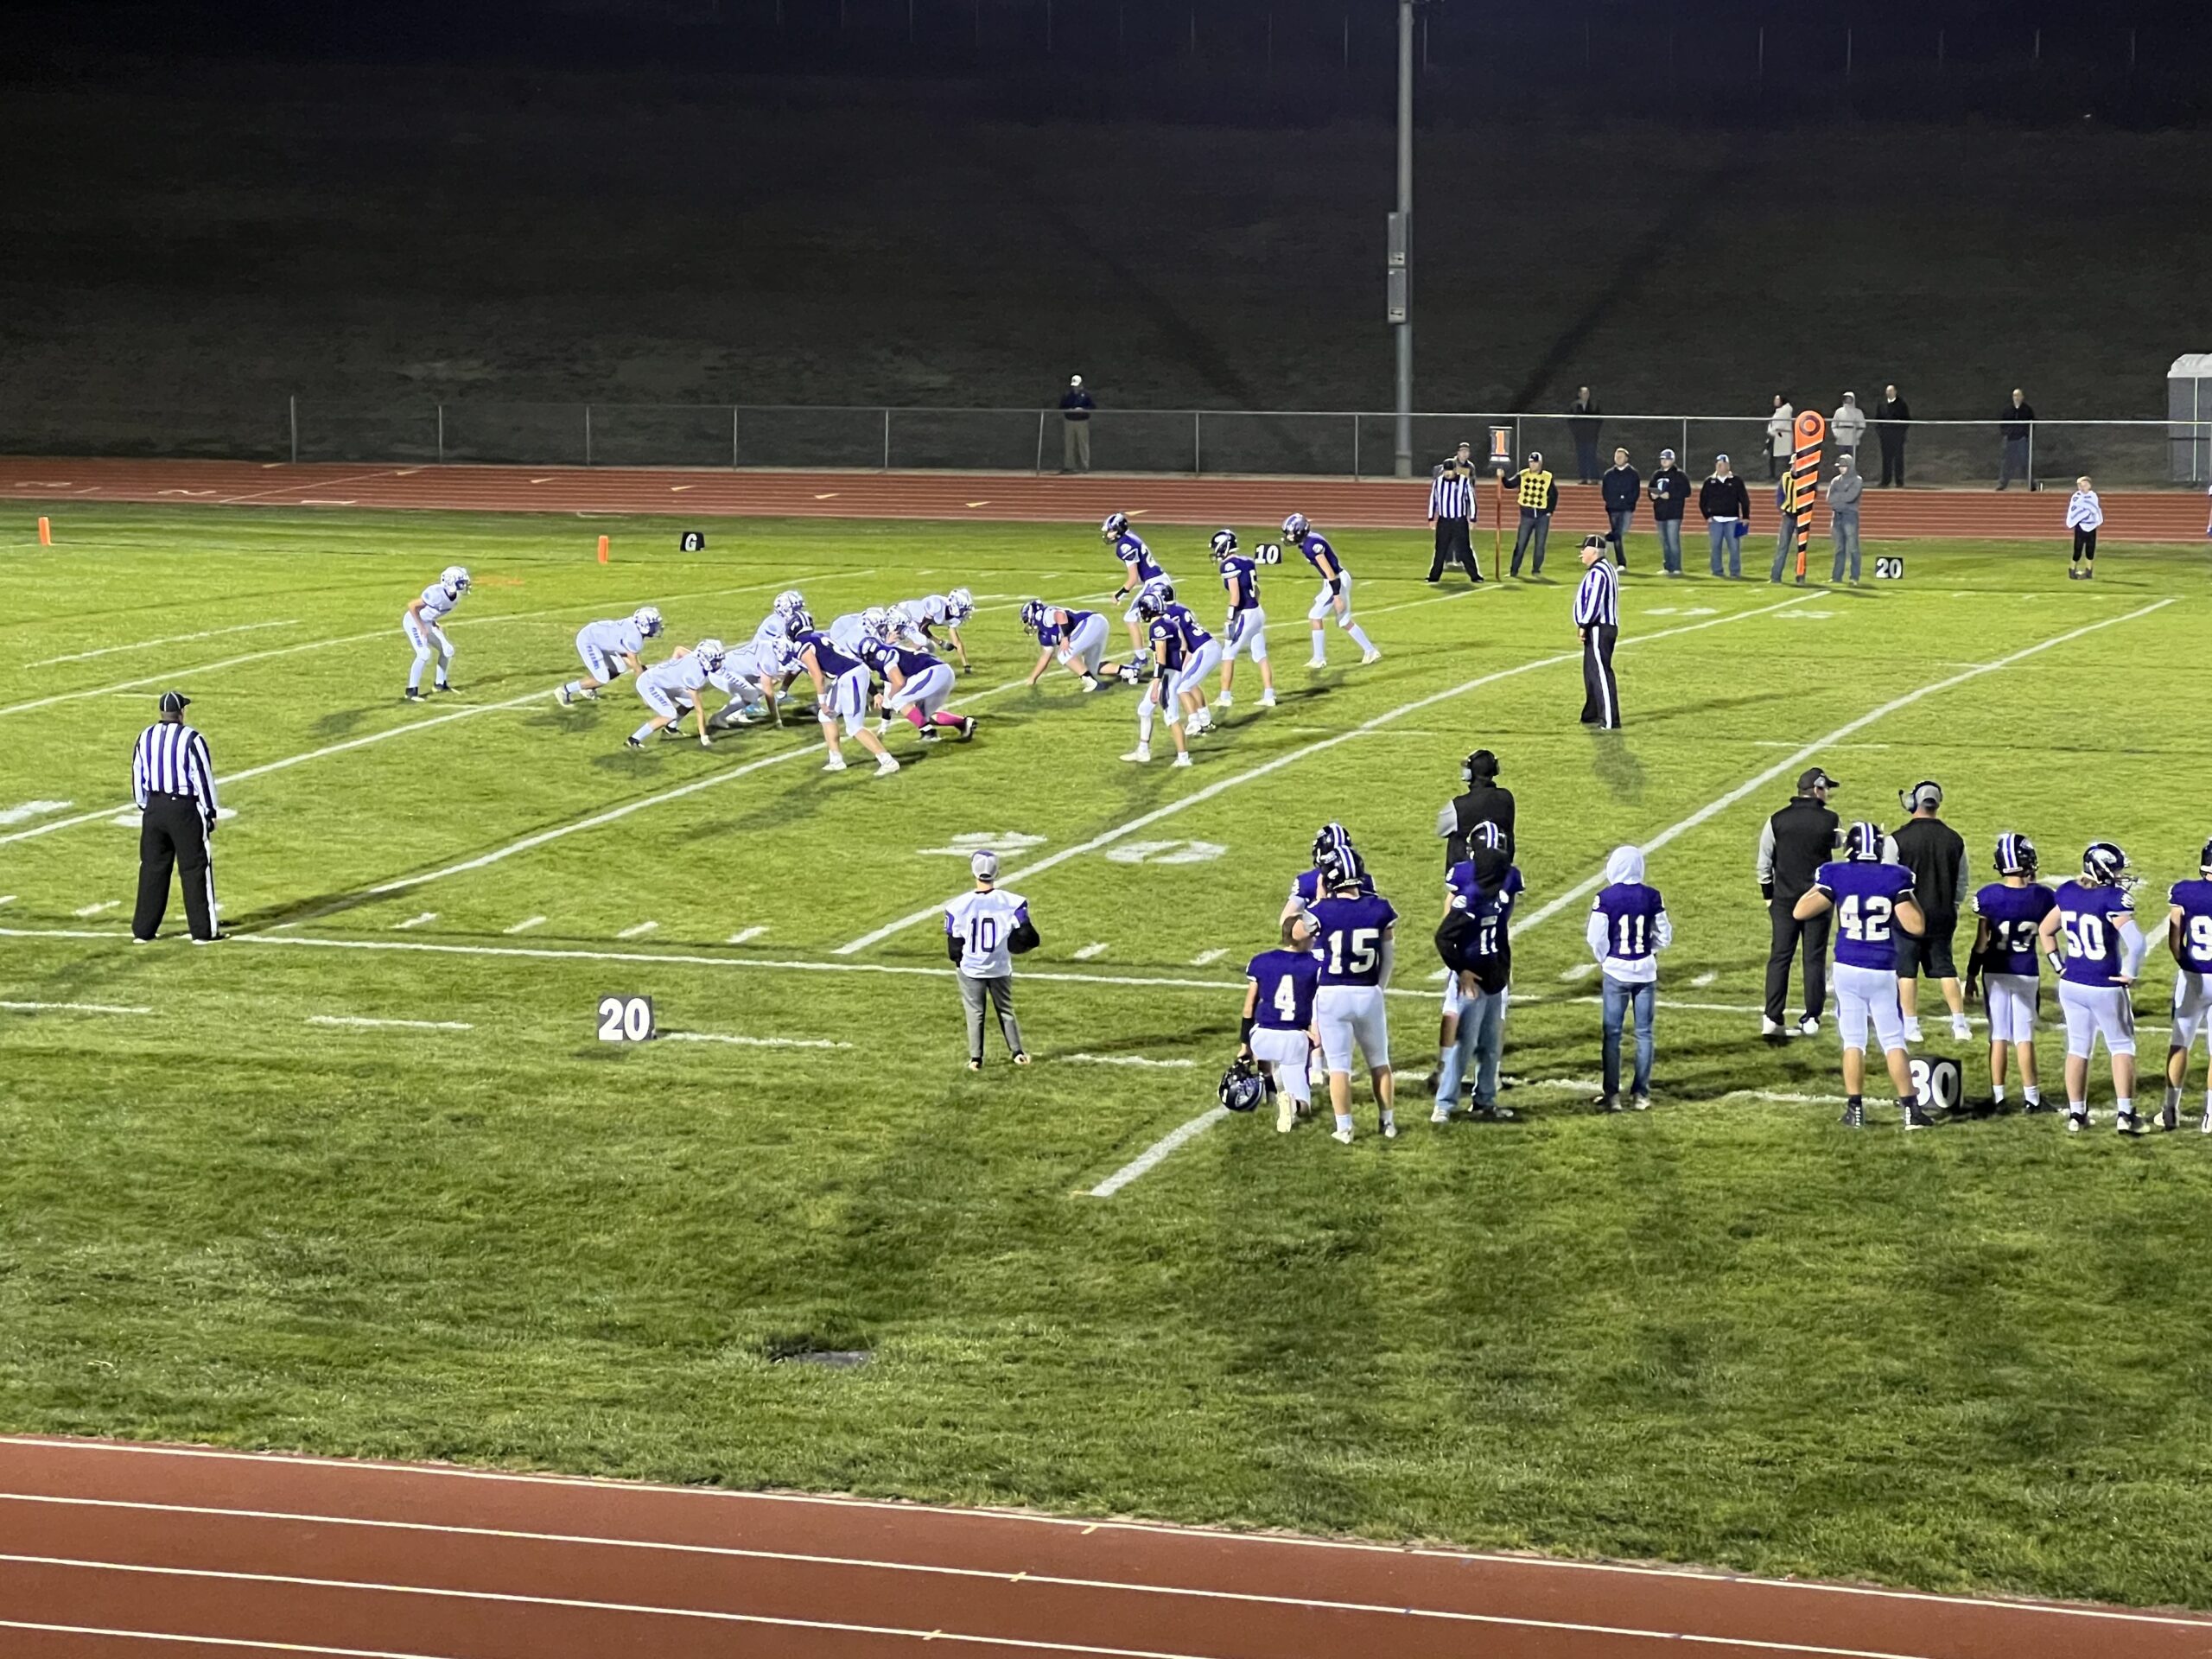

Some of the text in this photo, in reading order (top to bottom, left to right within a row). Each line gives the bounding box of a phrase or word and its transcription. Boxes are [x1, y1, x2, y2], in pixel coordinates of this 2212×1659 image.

[685, 533, 697, 551] G
[1255, 544, 1279, 564] 10
[1876, 557, 1903, 579] 20
[970, 917, 996, 953] 10
[1618, 914, 1645, 954] 11
[1840, 895, 1892, 941] 42
[1998, 920, 2039, 952] 13
[2061, 911, 2107, 960] 50
[1328, 928, 1380, 975] 15
[598, 997, 651, 1041] 20
[1274, 975, 1296, 1021] 4
[1909, 1059, 1959, 1109] 30
